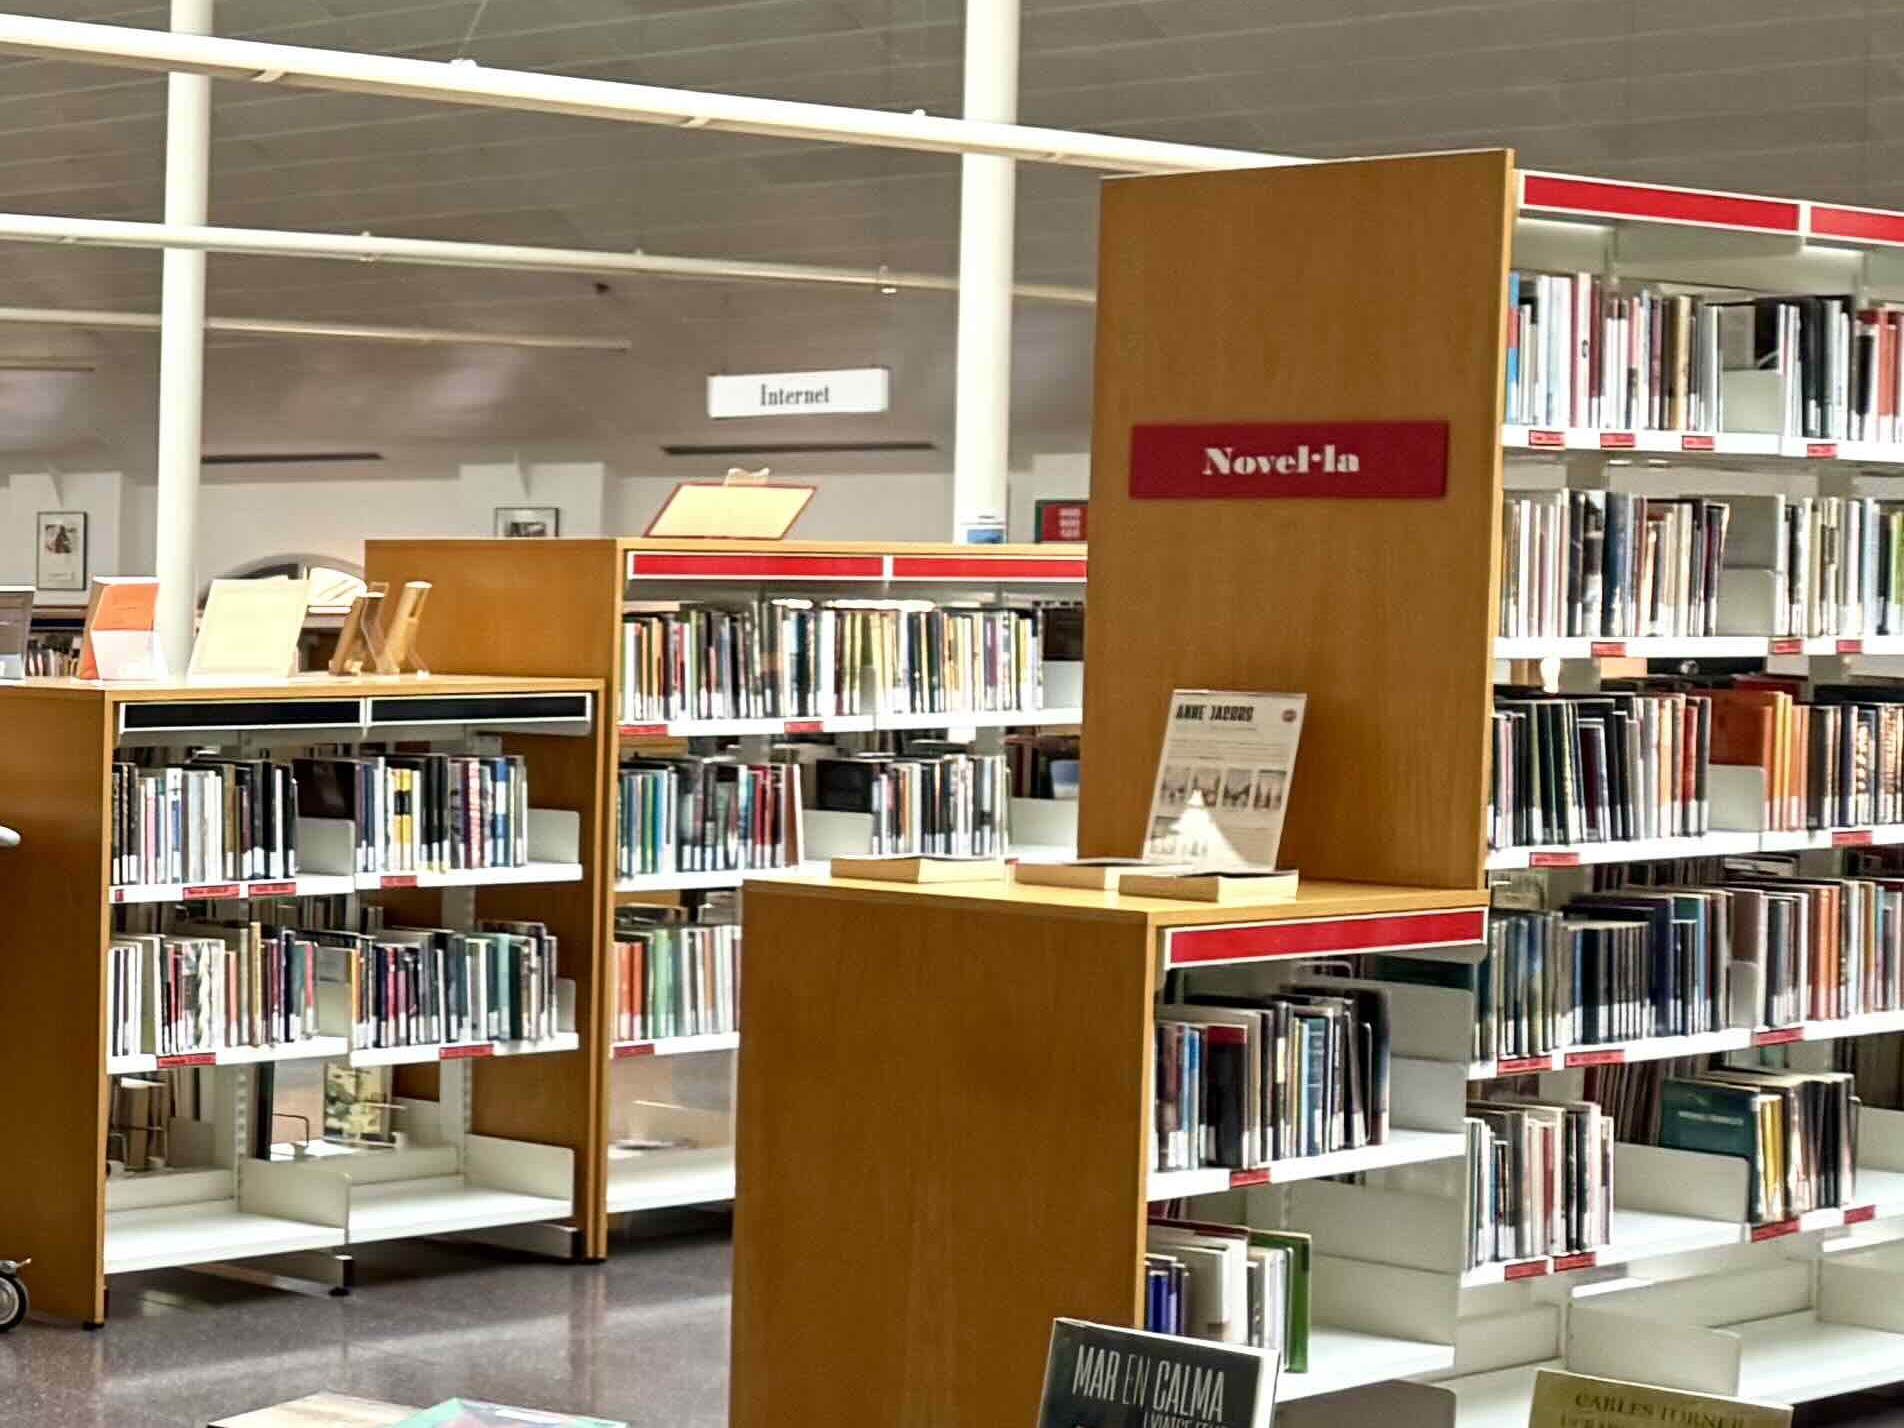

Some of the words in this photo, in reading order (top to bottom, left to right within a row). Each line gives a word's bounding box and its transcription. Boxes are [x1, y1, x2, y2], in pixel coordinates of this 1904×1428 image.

[759, 383, 830, 407] Internet
[1201, 444, 1360, 476] Novel·la
[1072, 1344, 1121, 1402] MAR
[1122, 1353, 1151, 1407] EN
[1152, 1359, 1225, 1423] CALMA
[1575, 1392, 1657, 1417] CARLES
